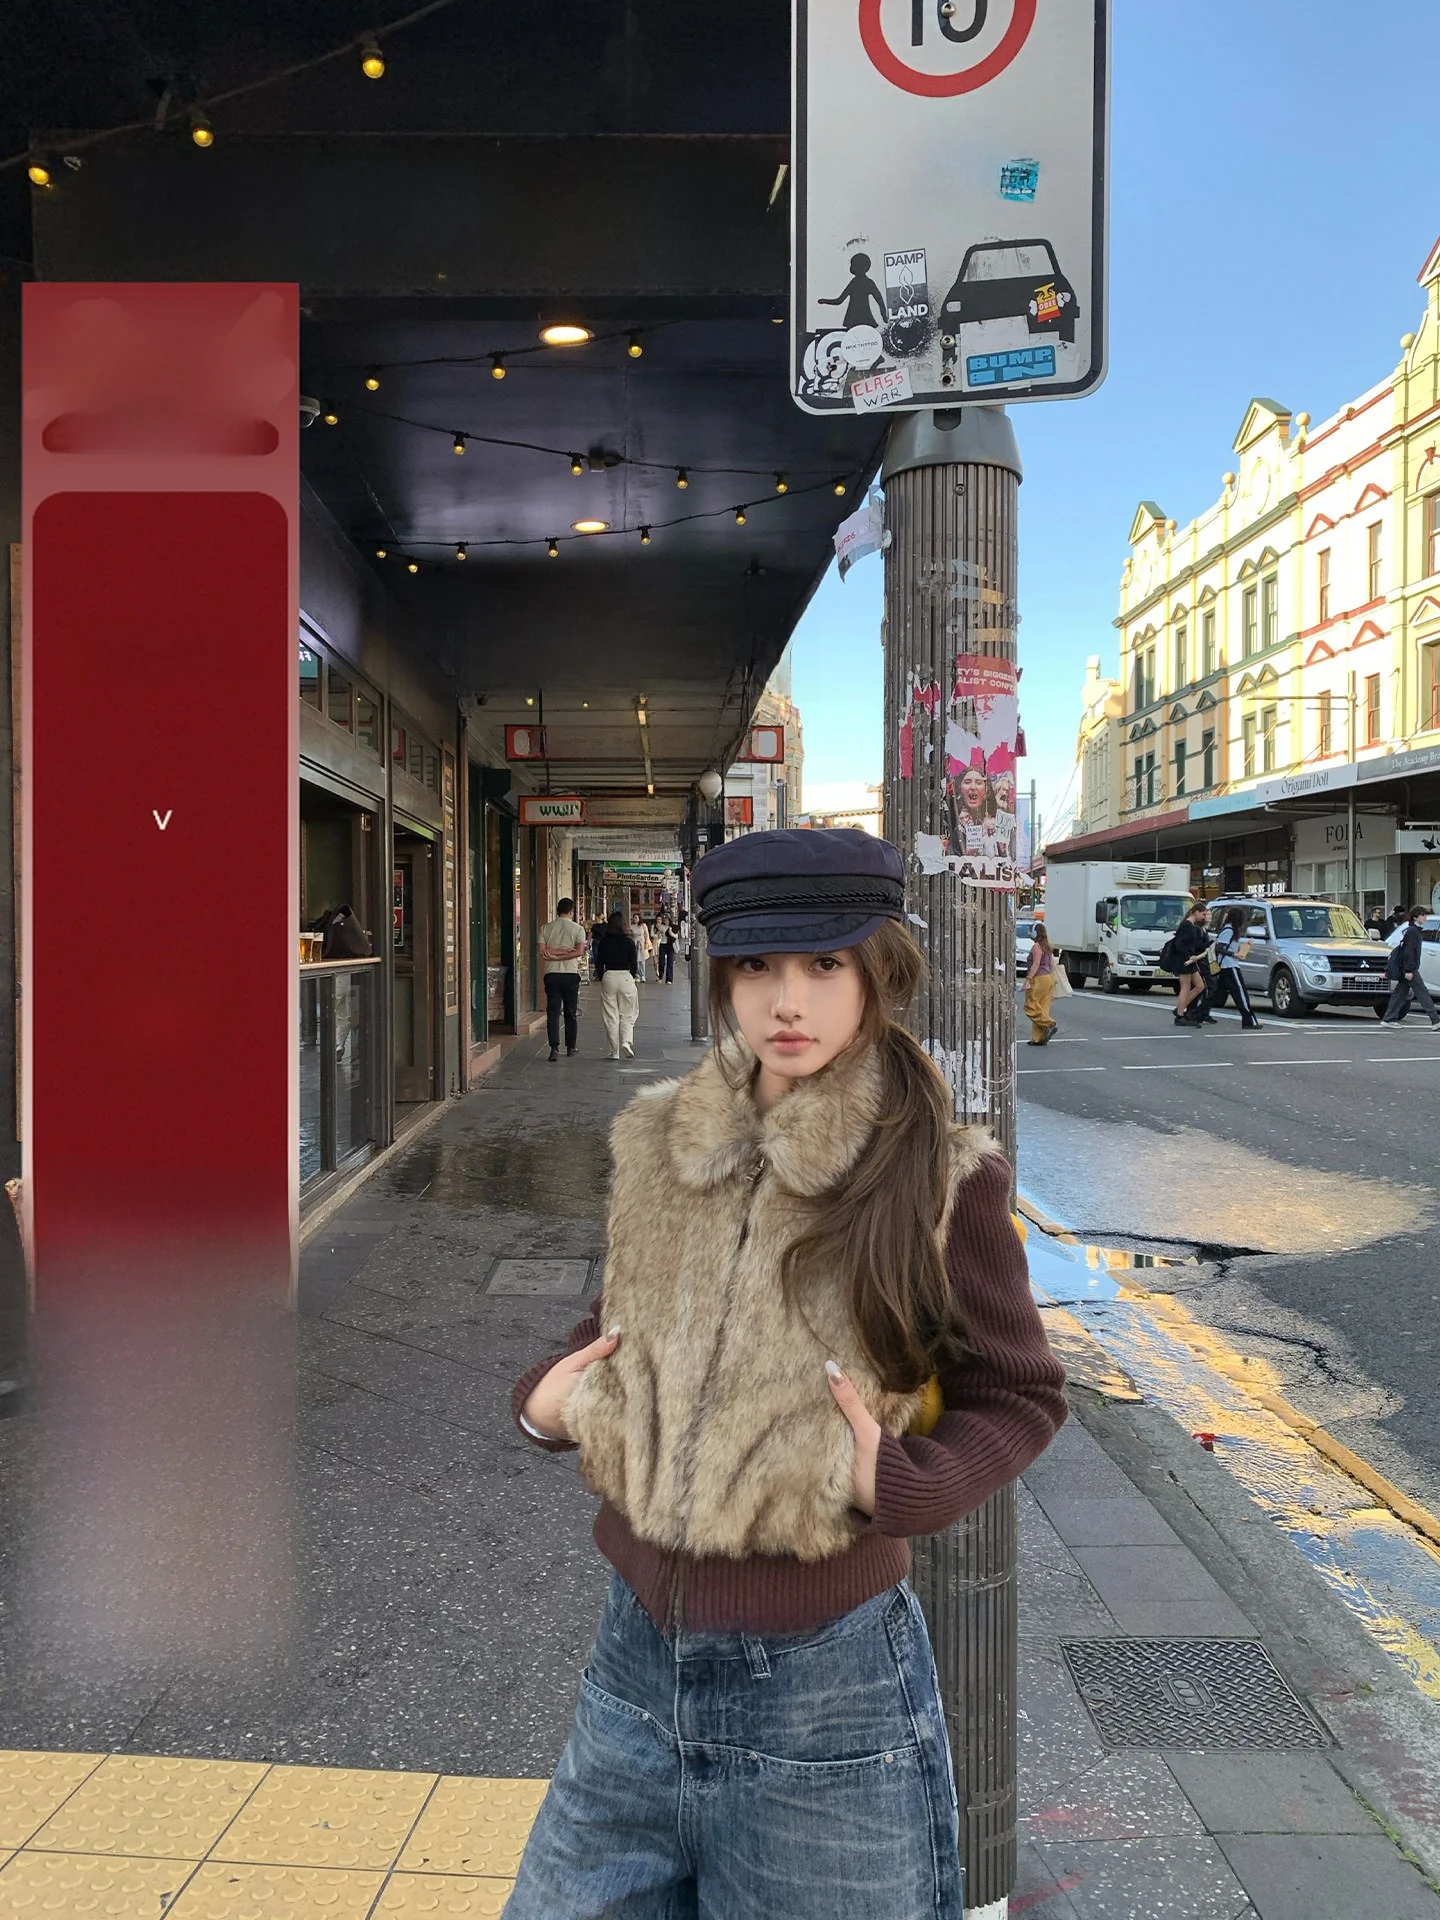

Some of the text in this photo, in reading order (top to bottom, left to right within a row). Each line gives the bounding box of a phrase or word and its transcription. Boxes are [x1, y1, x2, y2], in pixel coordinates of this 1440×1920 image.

[886, 252, 924, 267] DAMP
[888, 304, 929, 319] LAND
[853, 371, 905, 397] CLASS
[863, 388, 903, 408] WAR
[1403, 754, 1429, 767] Academy
[1281, 771, 1329, 795] Origami Doll
[616, 873, 660, 882] PhotoGarden
